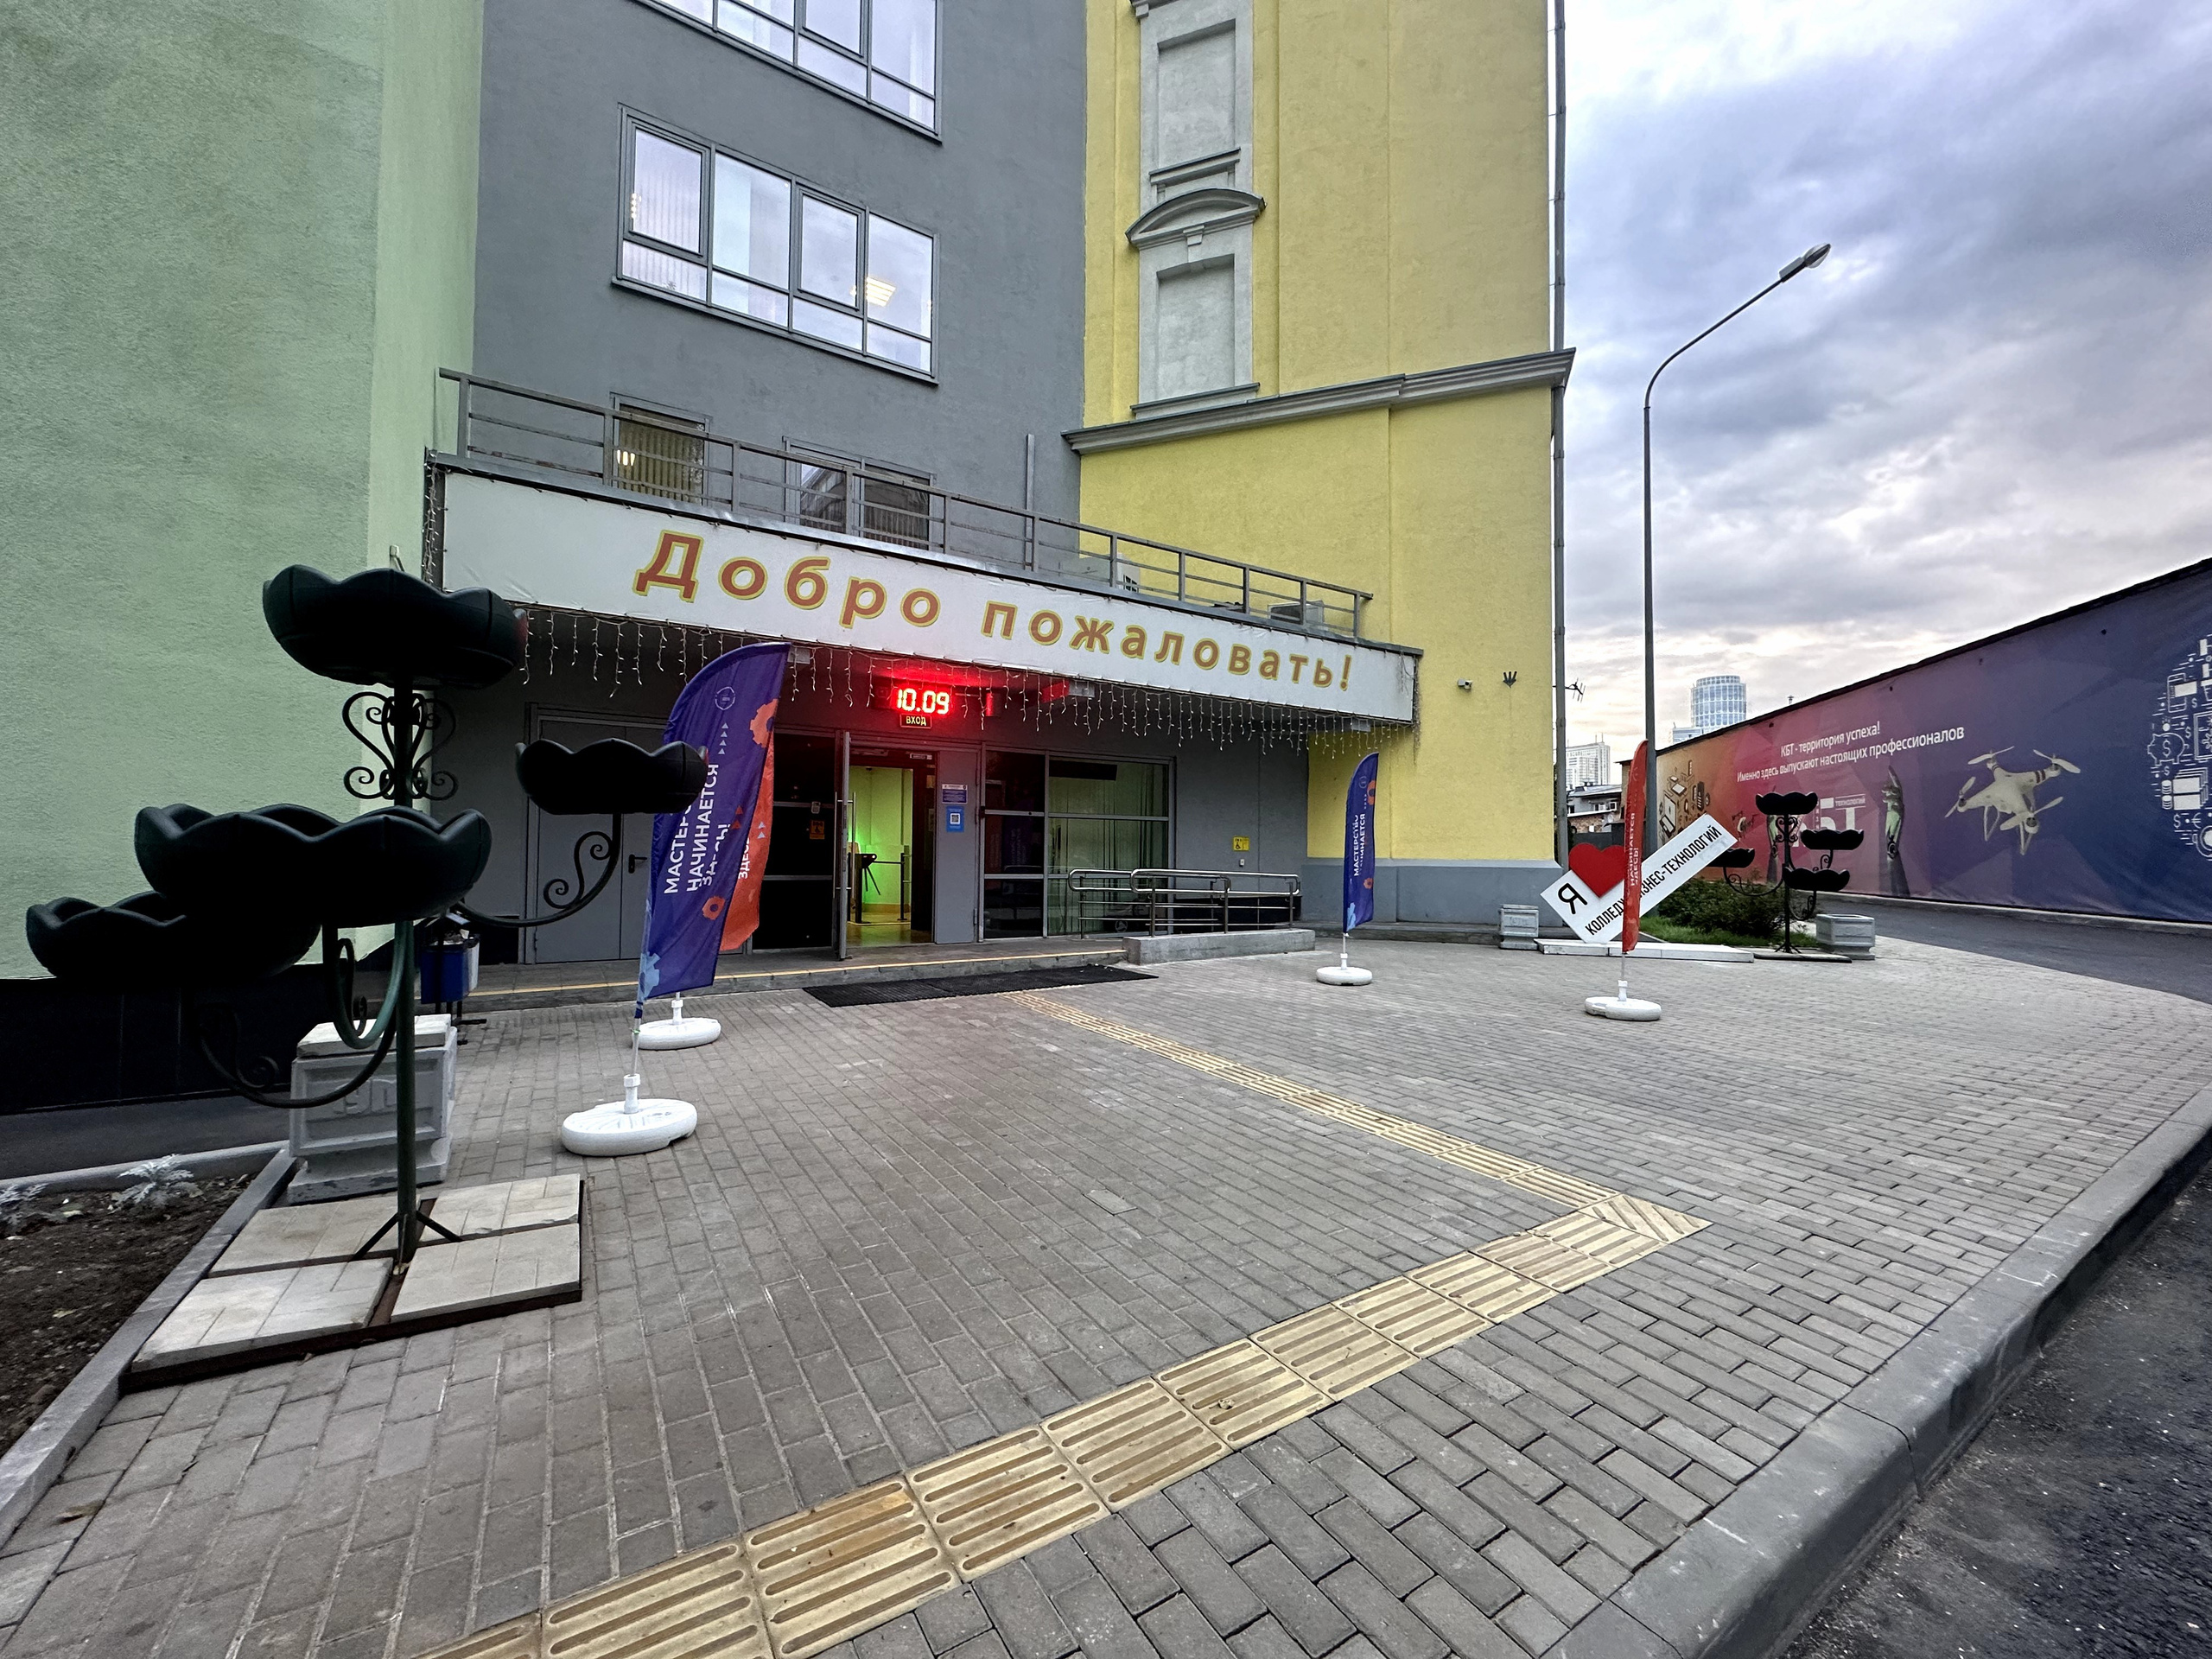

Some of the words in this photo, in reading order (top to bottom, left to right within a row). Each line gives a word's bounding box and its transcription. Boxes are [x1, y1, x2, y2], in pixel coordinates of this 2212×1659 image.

[632, 530, 941, 628] Добро
[981, 600, 1352, 691] пожаловать!
[906, 715, 927, 727] ВХОД
[1781, 743, 1795, 757] КБТ
[1799, 733, 1845, 753] территория
[1846, 721, 1880, 745] успеха!
[1737, 771, 1760, 782] Именно
[1760, 766, 1779, 780] здесь
[1780, 758, 1819, 774] выпускают
[1820, 747, 1867, 766] настоящих
[1869, 727, 1964, 759] профессионалов
[687, 764, 719, 892] НАЧИНАЕТСЯ
[1640, 824, 1722, 899] ЗНЕС-ТЕХНОЛОГИЙ
[1558, 882, 1588, 915] Я
